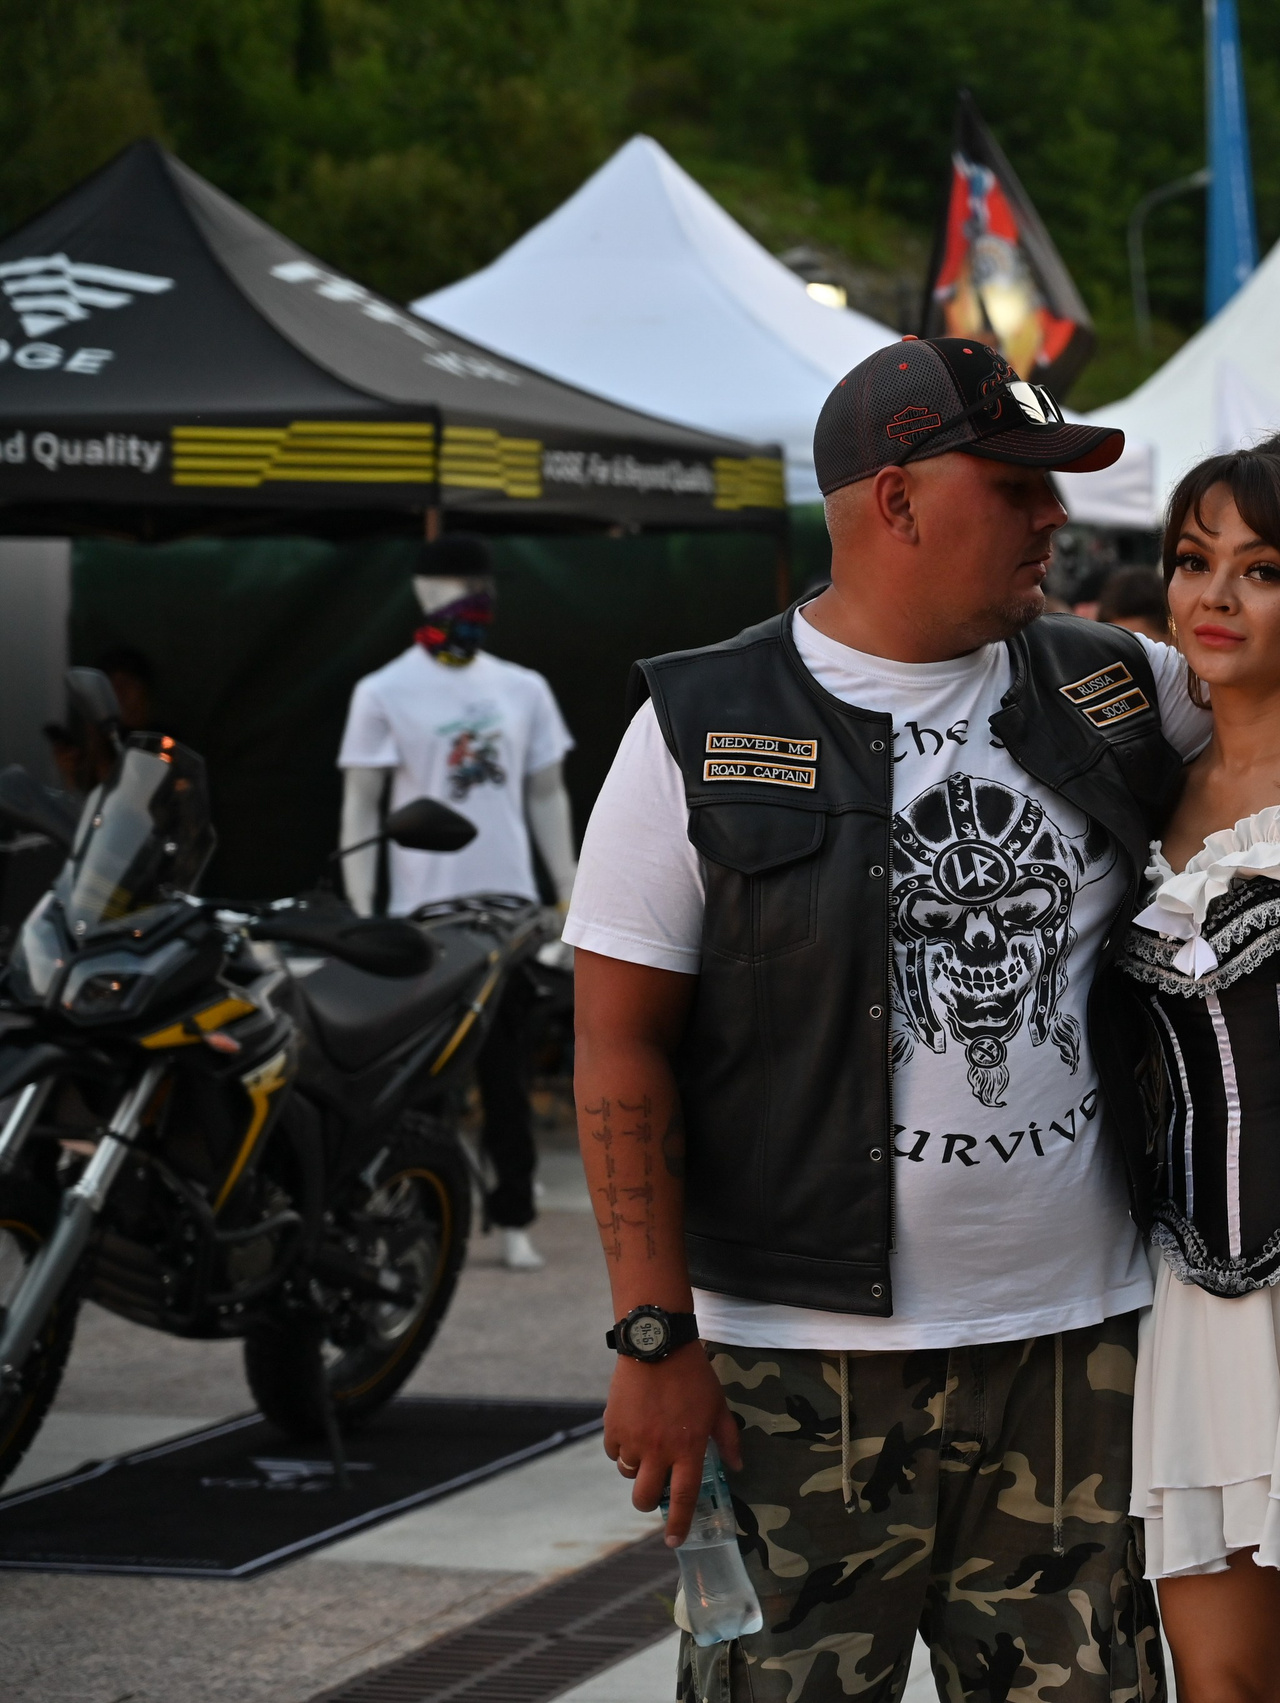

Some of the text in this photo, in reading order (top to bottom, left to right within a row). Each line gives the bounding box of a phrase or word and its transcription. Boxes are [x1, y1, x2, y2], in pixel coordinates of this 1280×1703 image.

[0, 338, 115, 375] GE
[32, 431, 163, 474] Quality
[1076, 674, 1115, 696] RUSSIA
[1101, 699, 1131, 718] SOCHI
[711, 737, 812, 756] MEDVEDI MC
[710, 764, 809, 783] ROAD CAPTAIN
